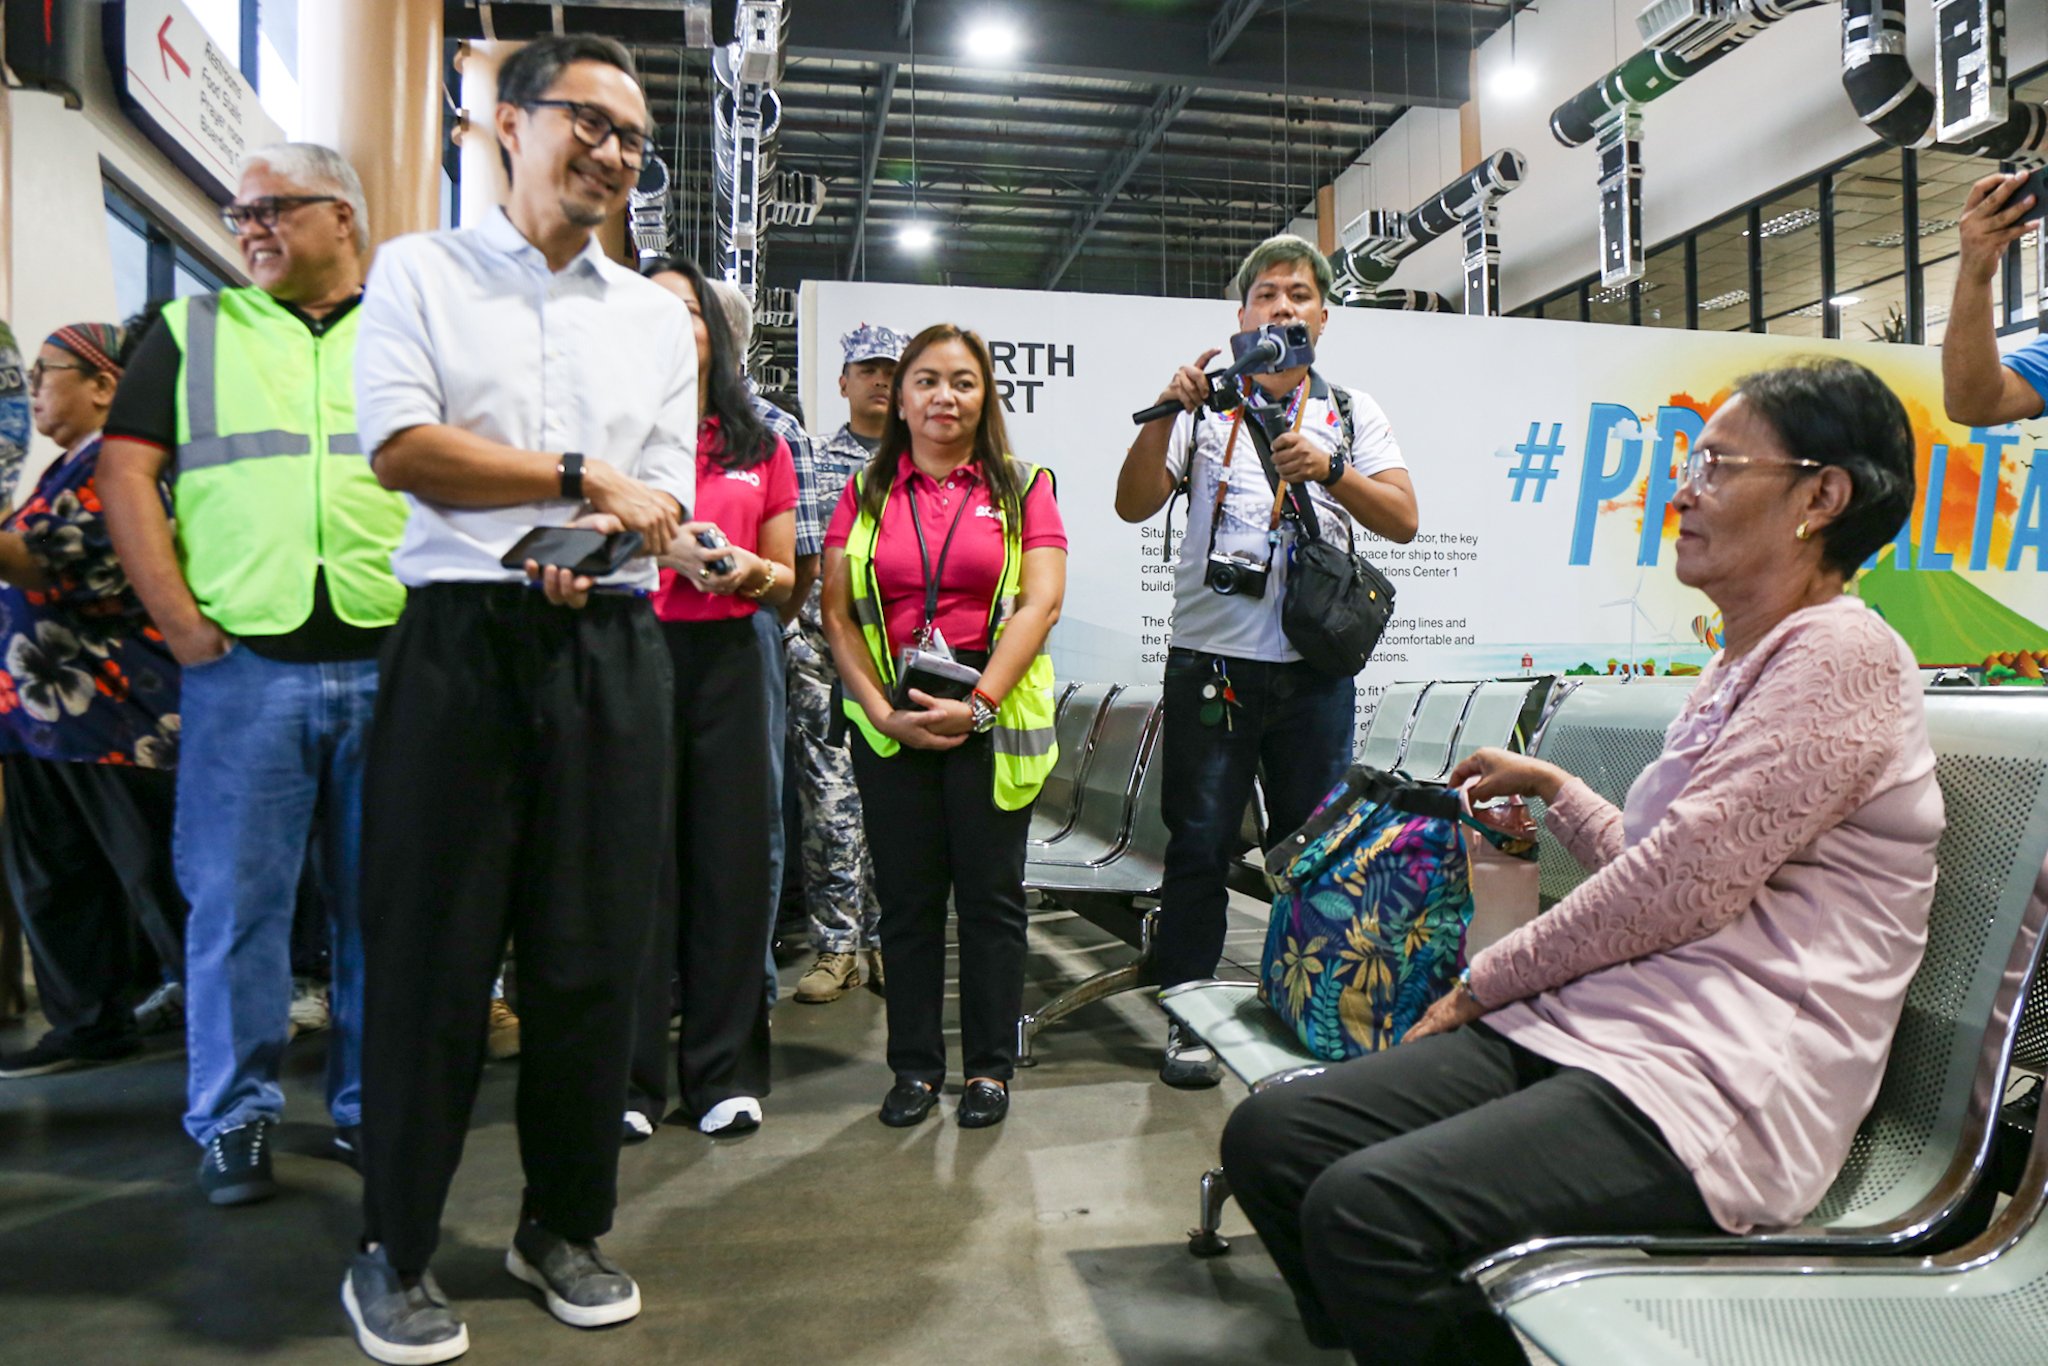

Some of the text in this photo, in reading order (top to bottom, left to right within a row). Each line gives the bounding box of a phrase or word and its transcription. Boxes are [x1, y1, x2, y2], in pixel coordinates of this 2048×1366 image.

[202, 66, 220, 100] Food
[988, 341, 1074, 377] RTH
[995, 380, 1044, 413] RT
[1440, 533, 1457, 544] the
[1460, 533, 1479, 546] key
[1391, 549, 1405, 560] for
[1408, 550, 1431, 562] ship
[1434, 550, 1444, 560] to
[1447, 550, 1477, 560] shore
[1413, 566, 1450, 577] Center
[1453, 567, 1458, 577] 1
[1141, 580, 1174, 592] buildi
[1141, 615, 1165, 627] The
[1418, 617, 1443, 628] lines
[1445, 618, 1466, 628] and
[1141, 633, 1161, 645] the
[1385, 634, 1452, 645] comfortable
[1454, 635, 1475, 645] and
